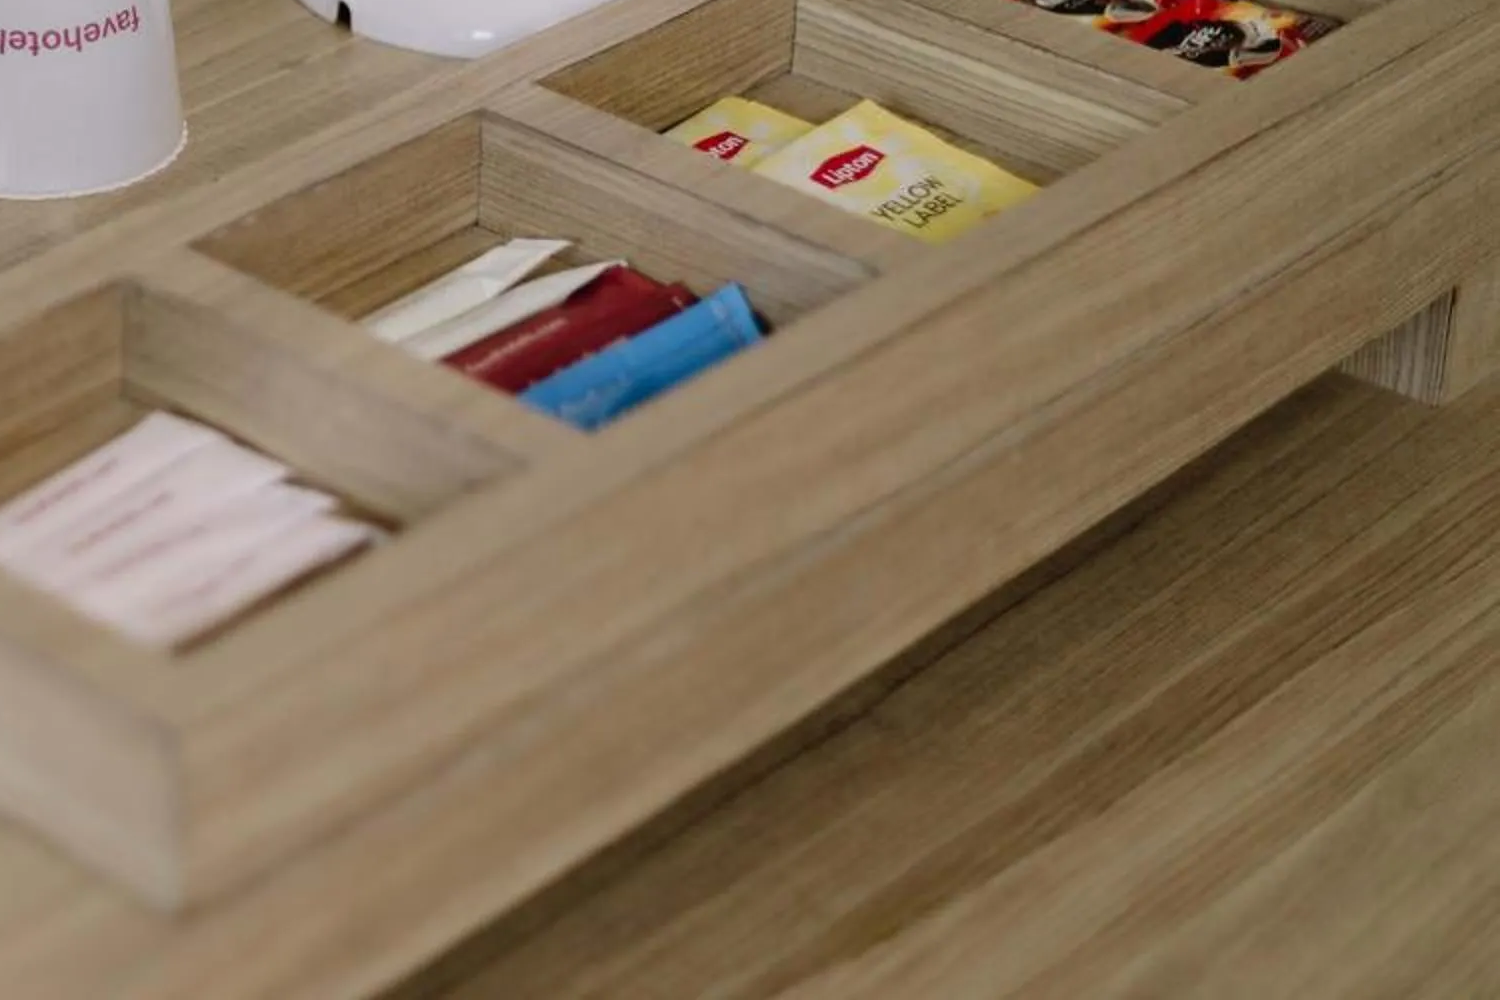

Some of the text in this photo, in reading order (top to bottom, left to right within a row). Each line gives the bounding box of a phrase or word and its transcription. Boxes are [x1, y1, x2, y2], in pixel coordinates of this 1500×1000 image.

[821, 151, 880, 185] Lipton
[870, 173, 945, 222] YELLOW
[902, 191, 965, 229] LABEL
